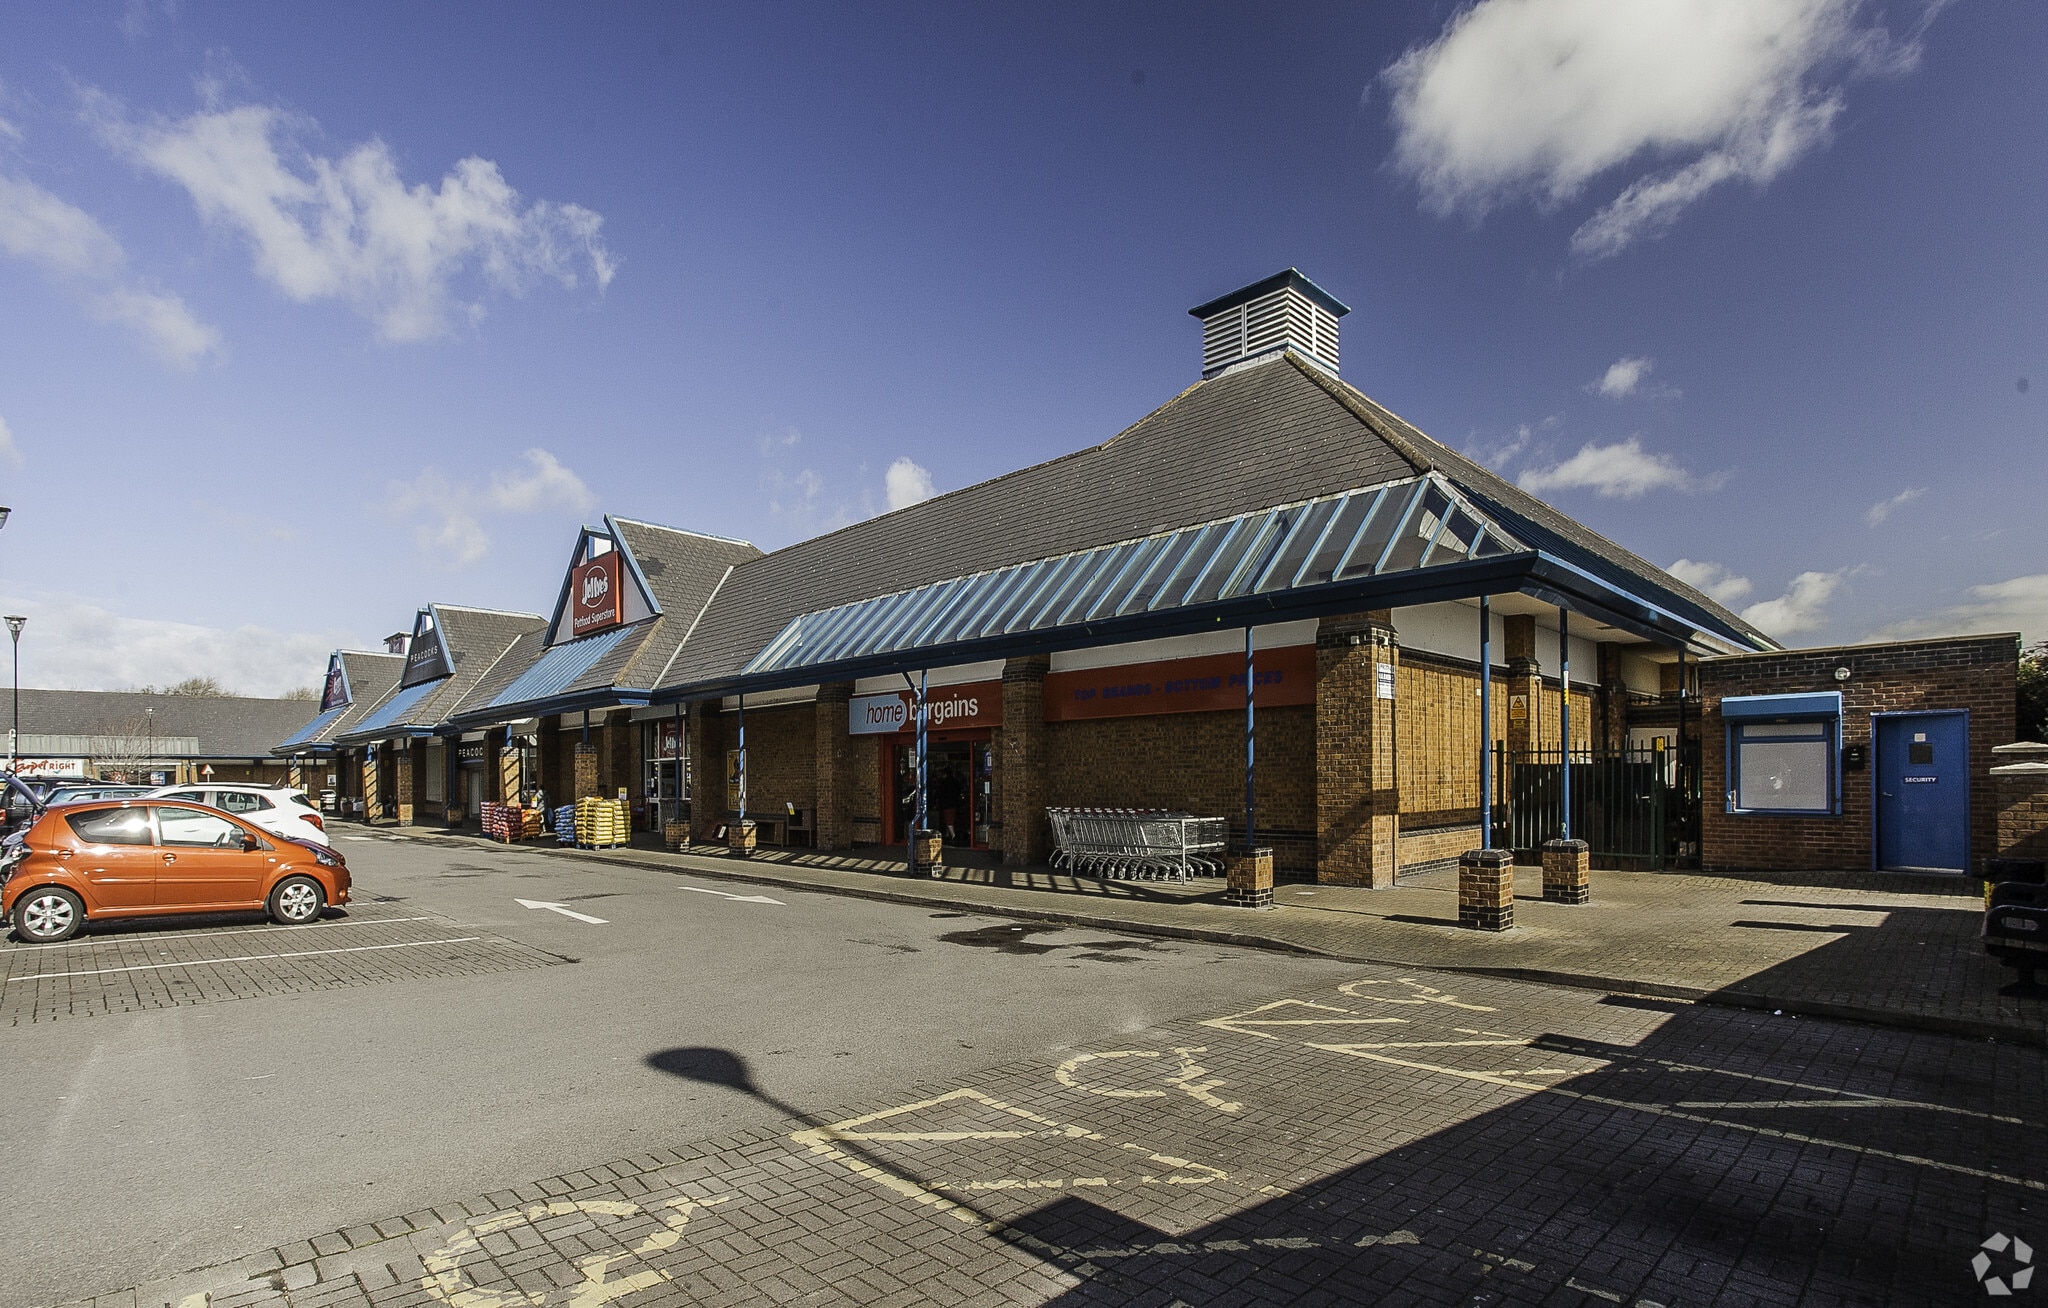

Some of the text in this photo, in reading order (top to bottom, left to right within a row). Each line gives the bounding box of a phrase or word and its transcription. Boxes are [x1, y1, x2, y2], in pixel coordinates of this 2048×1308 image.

[574, 607, 615, 628] Petfood Superstore
[410, 645, 438, 663] PEACOCKS
[1074, 687, 1096, 701] TOP
[1102, 683, 1151, 699] BRANDS
[1165, 676, 1221, 694] BOTTOM
[1228, 670, 1283, 687] PRCES
[866, 694, 978, 724] home brgains
